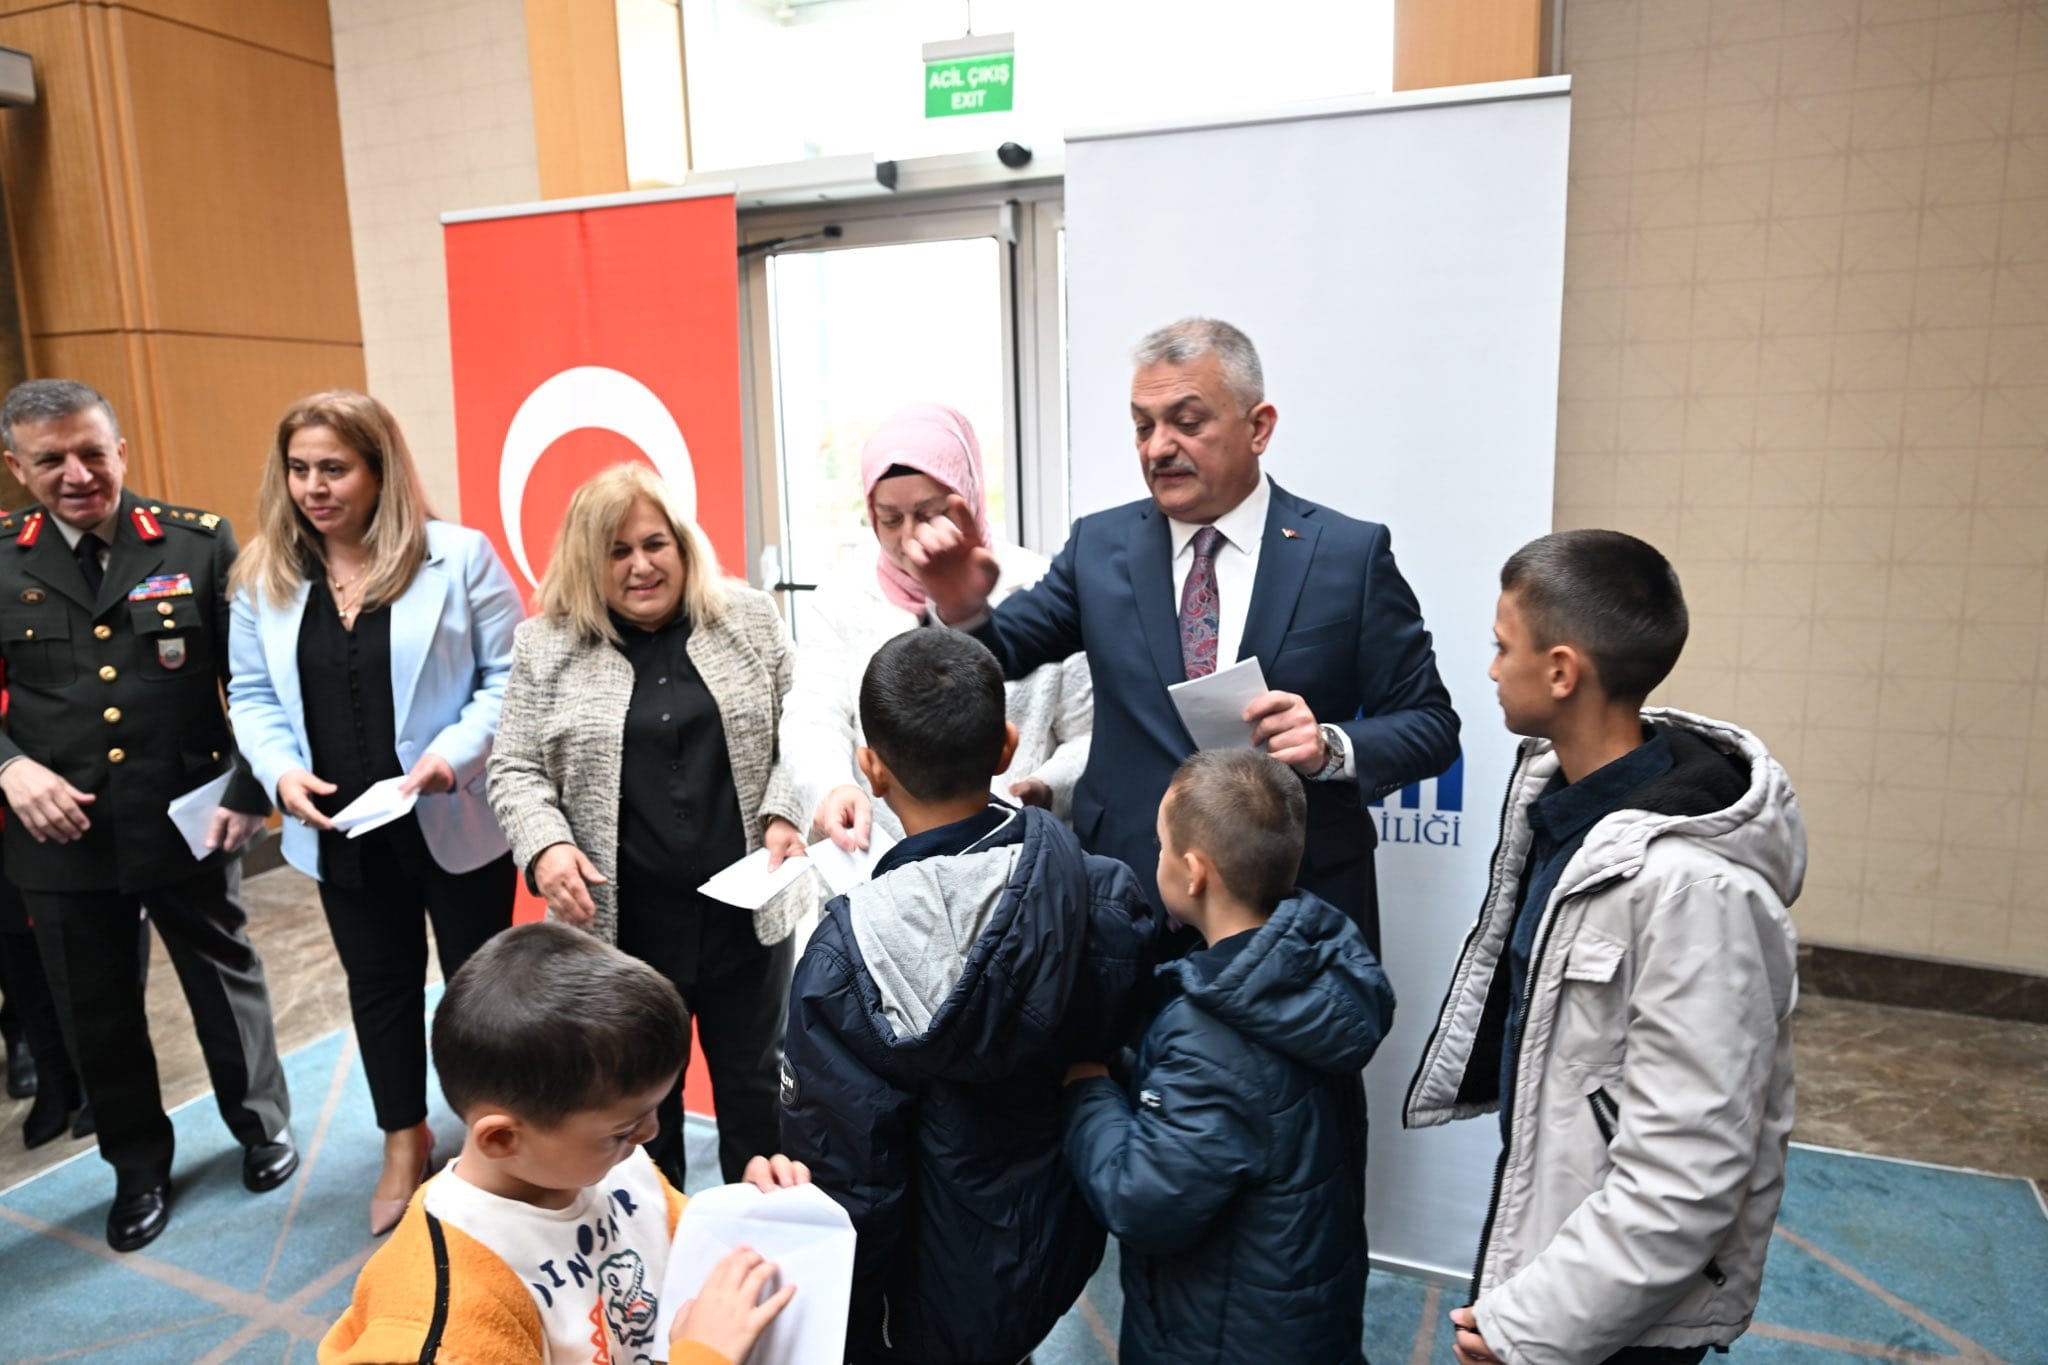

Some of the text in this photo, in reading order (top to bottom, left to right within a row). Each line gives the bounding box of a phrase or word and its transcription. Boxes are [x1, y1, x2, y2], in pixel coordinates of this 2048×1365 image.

[928, 64, 1010, 89] ACİL ÇIKIŞ
[951, 89, 987, 110] EXIT
[1381, 811, 1462, 846] İLİĞİ
